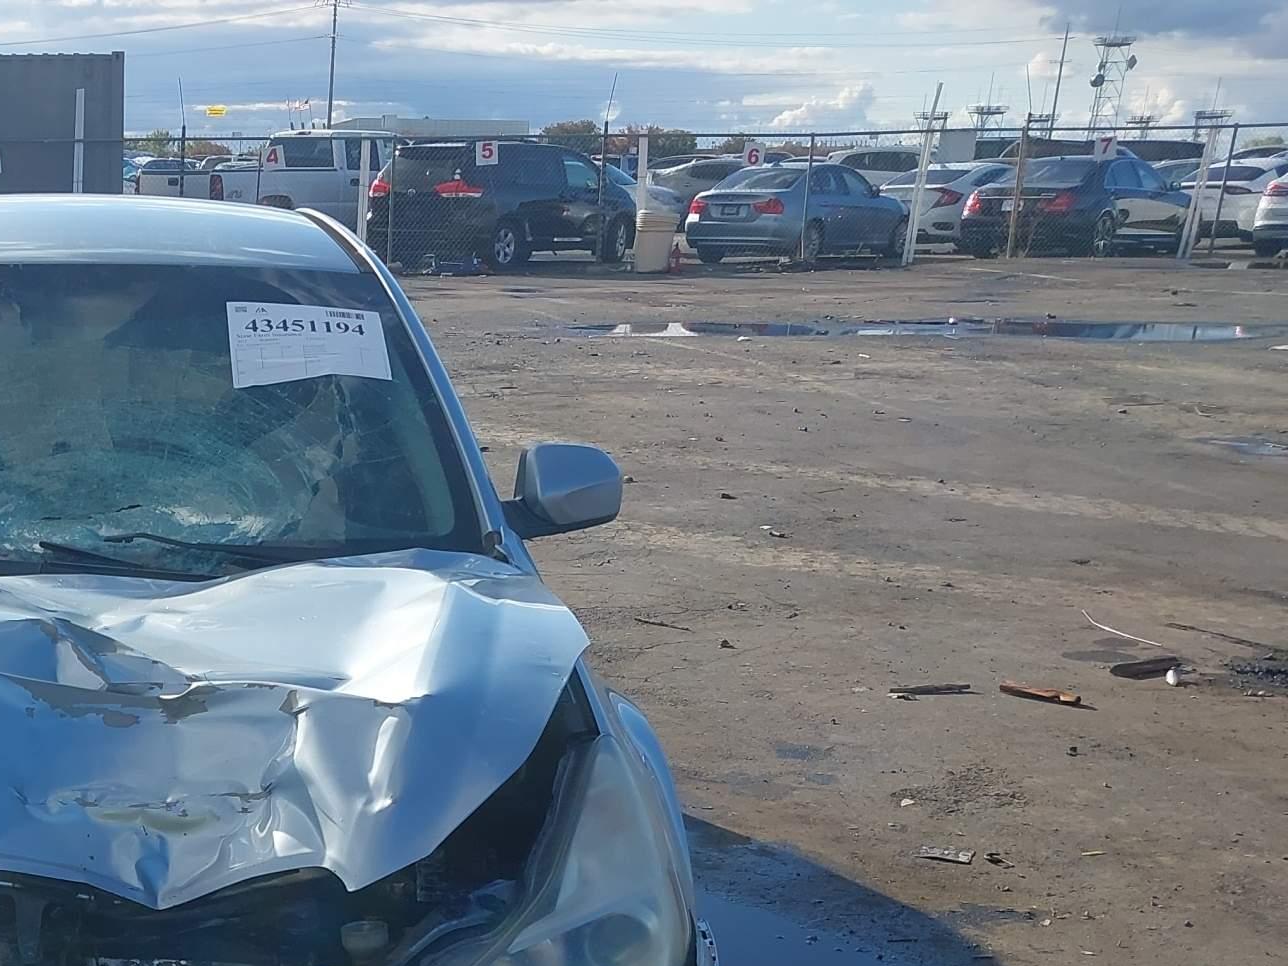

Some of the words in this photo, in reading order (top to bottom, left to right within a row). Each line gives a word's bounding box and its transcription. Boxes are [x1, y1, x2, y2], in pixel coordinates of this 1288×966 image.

[482, 143, 494, 160] 5
[1100, 138, 1113, 154] 7
[266, 148, 279, 164] 4
[747, 148, 760, 165] 6
[244, 319, 365, 336] 43451194
